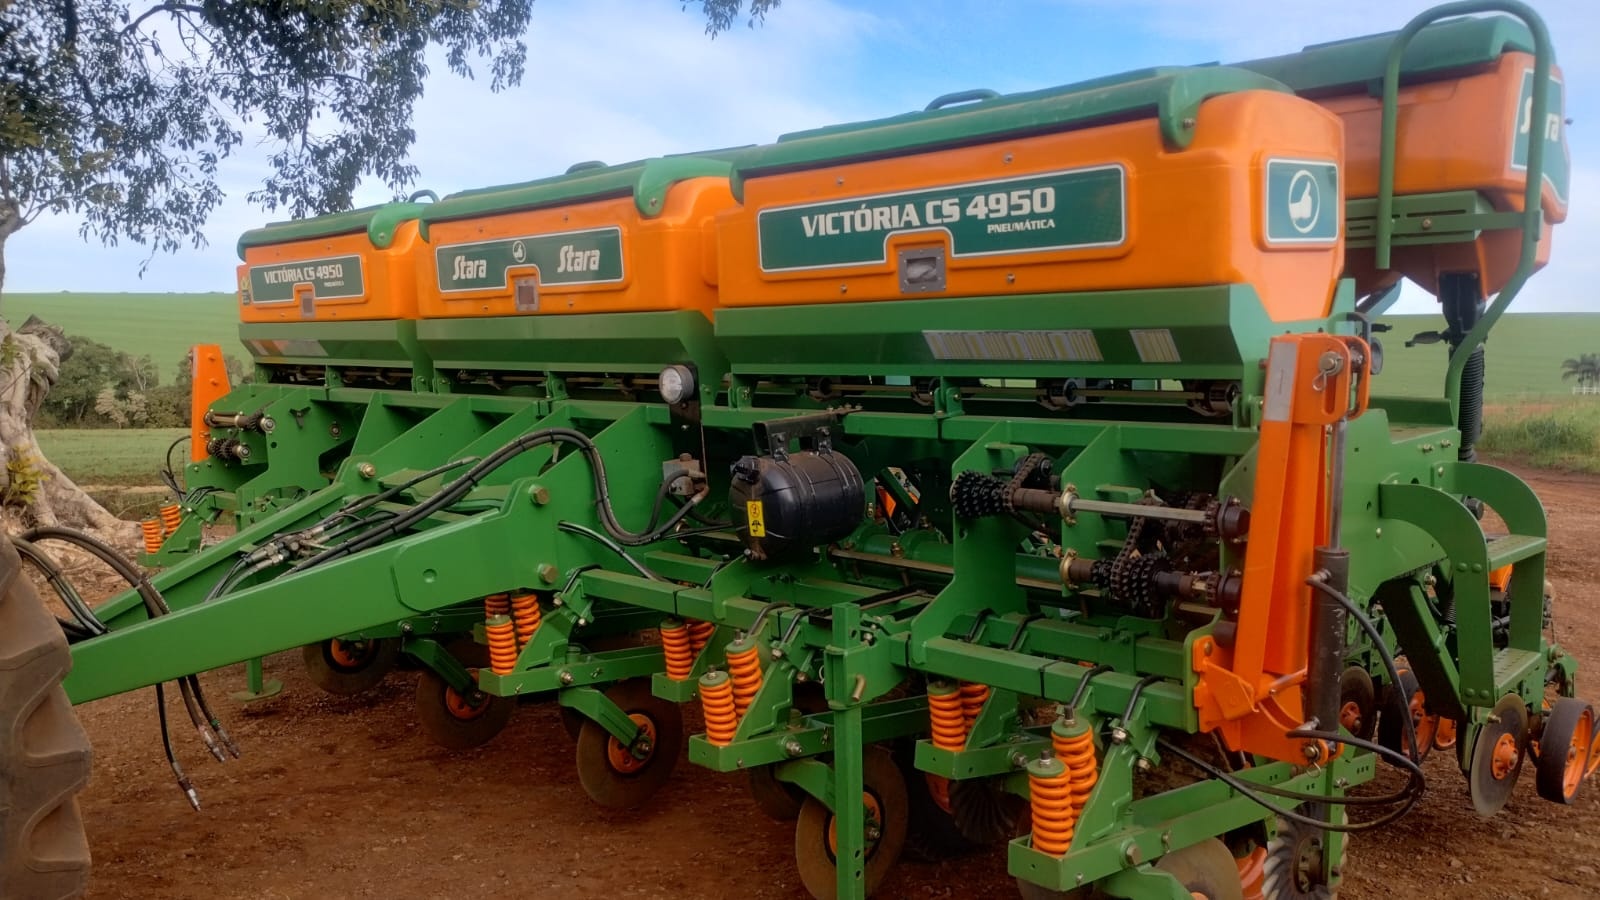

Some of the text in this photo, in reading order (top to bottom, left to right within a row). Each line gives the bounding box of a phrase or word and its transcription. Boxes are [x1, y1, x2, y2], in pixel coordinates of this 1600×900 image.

[1520, 96, 1560, 142] Sra
[801, 187, 1056, 238] VICTÓRIA CS 4950
[987, 218, 1056, 235] PNEUMÁTICA
[452, 255, 487, 281] Stara
[557, 244, 601, 273] Stara
[264, 264, 343, 285] VICTÓRIA CS 4950
